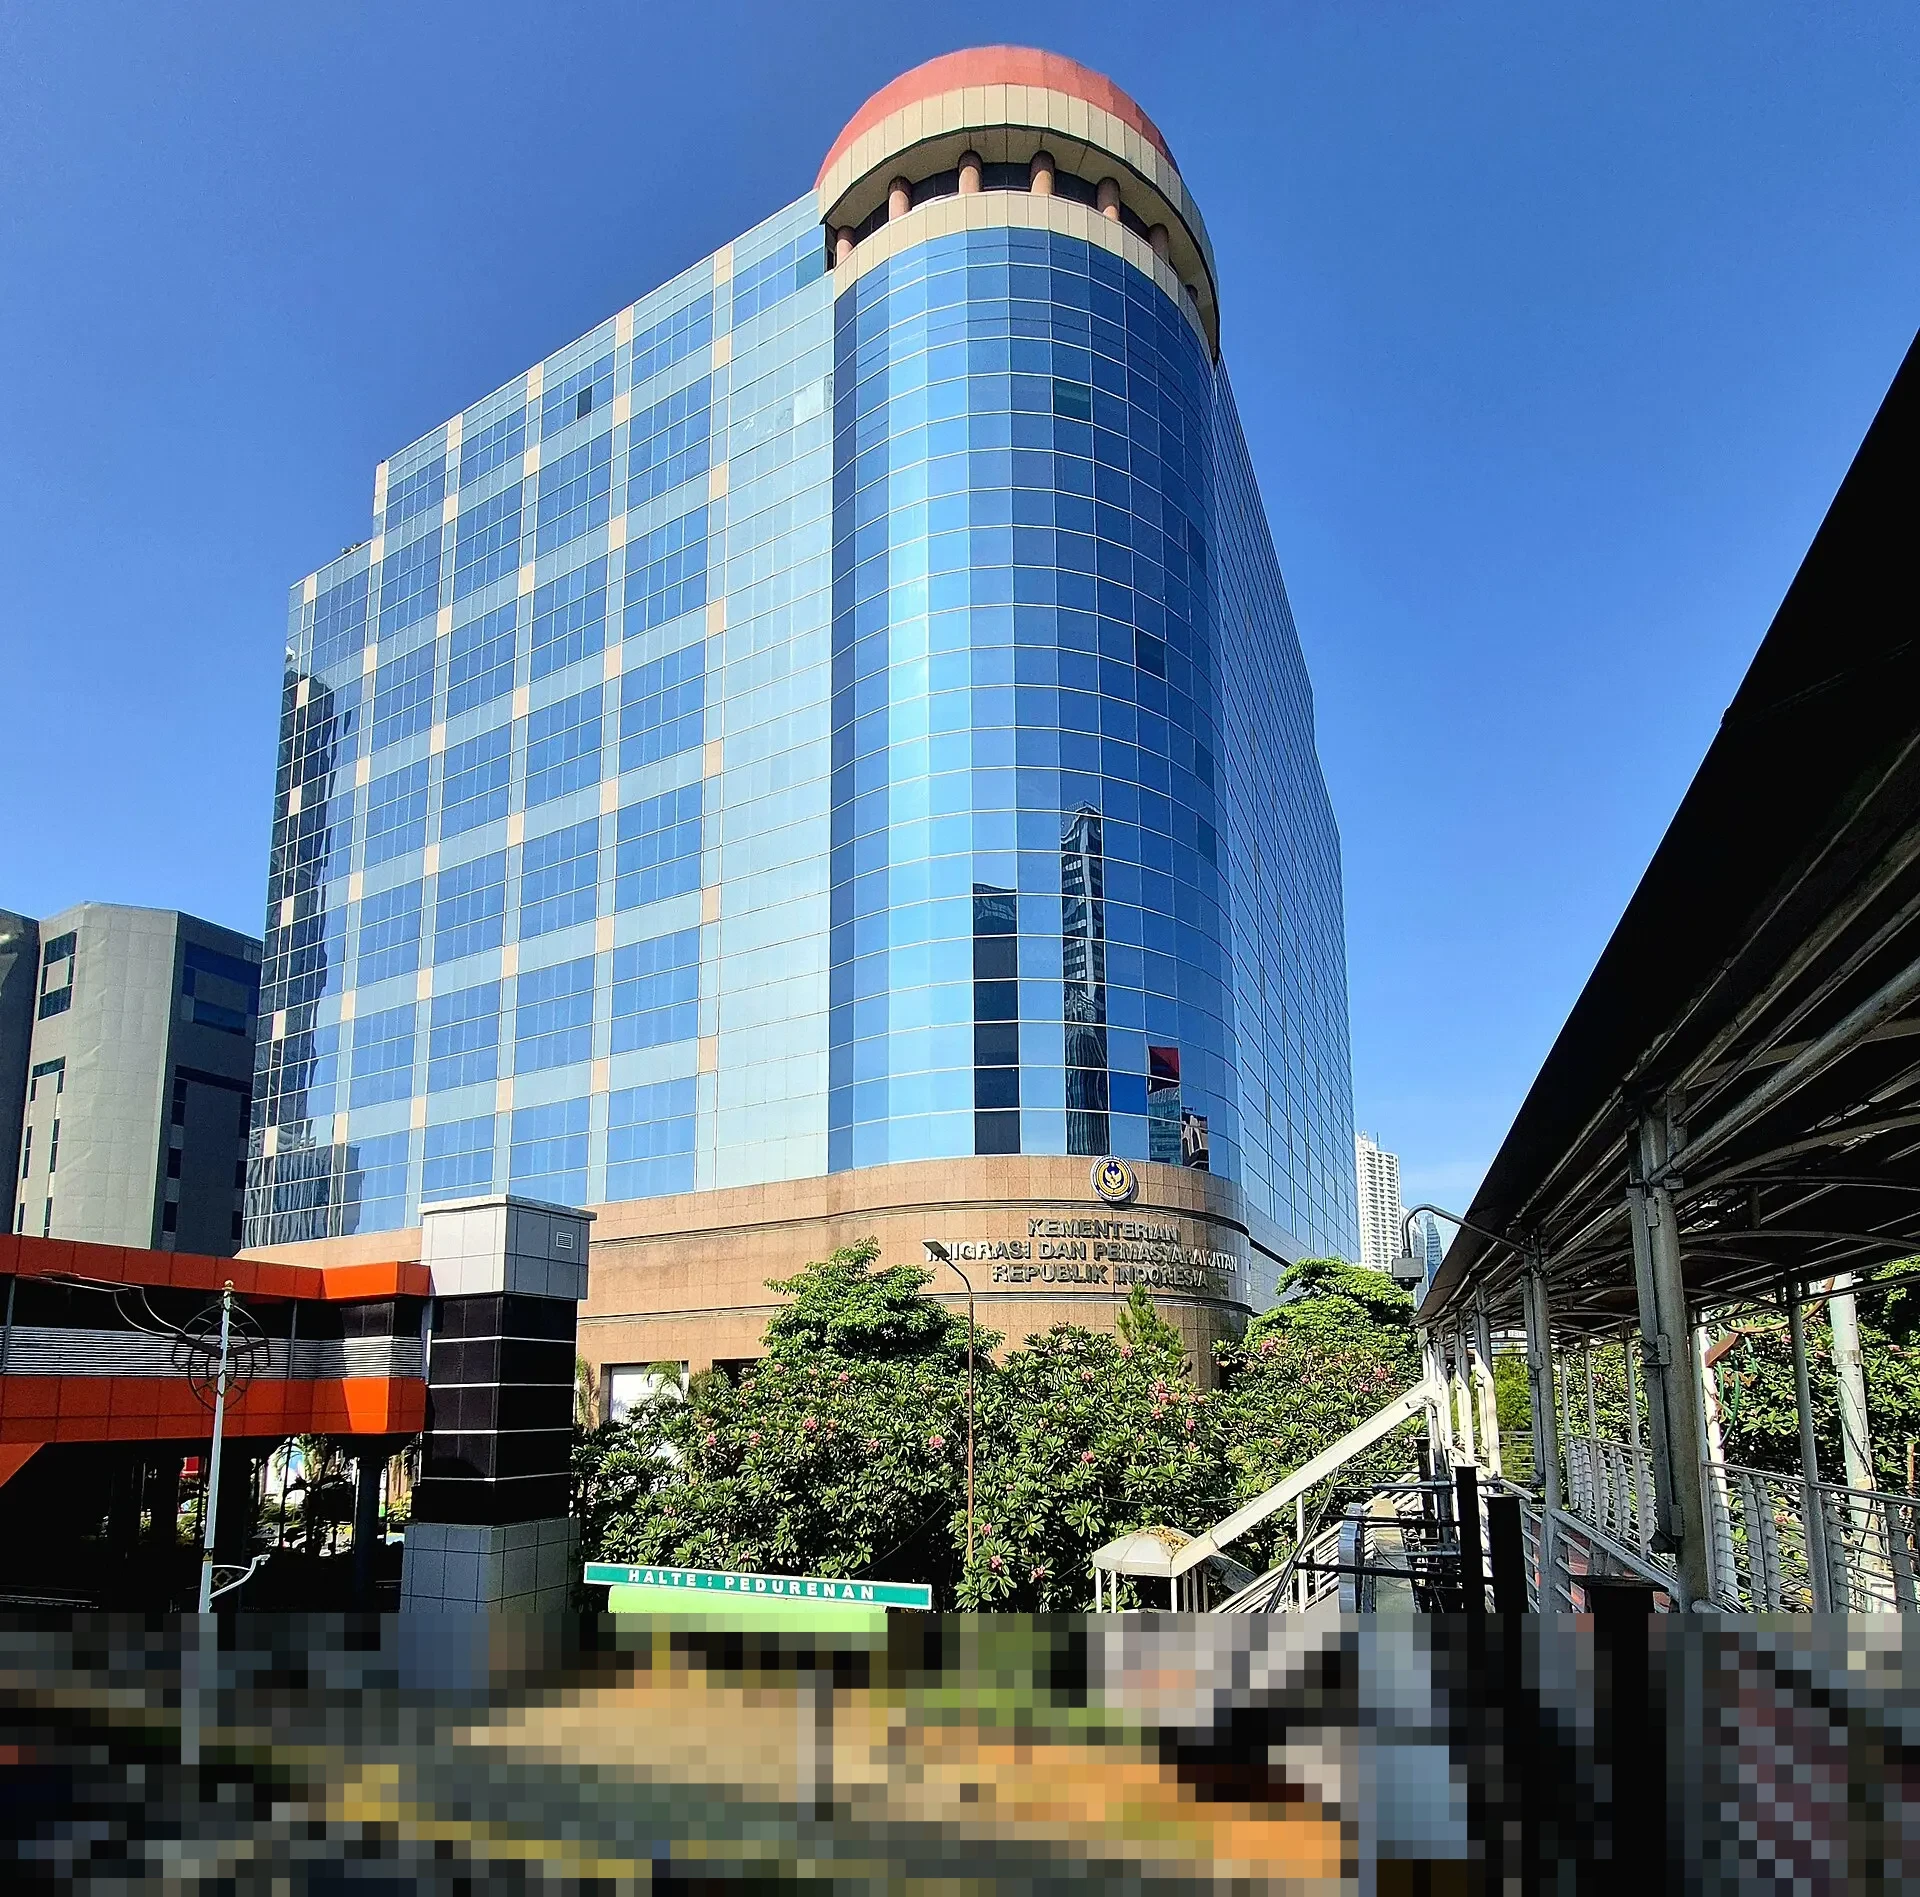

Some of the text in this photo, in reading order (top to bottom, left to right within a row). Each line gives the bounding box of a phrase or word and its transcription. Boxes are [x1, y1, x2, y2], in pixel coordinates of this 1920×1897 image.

[1027, 1218, 1179, 1243] KEMENTERIAN
[1038, 1240, 1087, 1261] DAN
[1094, 1241, 1238, 1272] PEMASYARAKATAN
[993, 1263, 1209, 1288] REPUBLIK INDONESIA
[628, 1569, 697, 1587] HALTE
[724, 1576, 875, 1600] PEDURENAN
